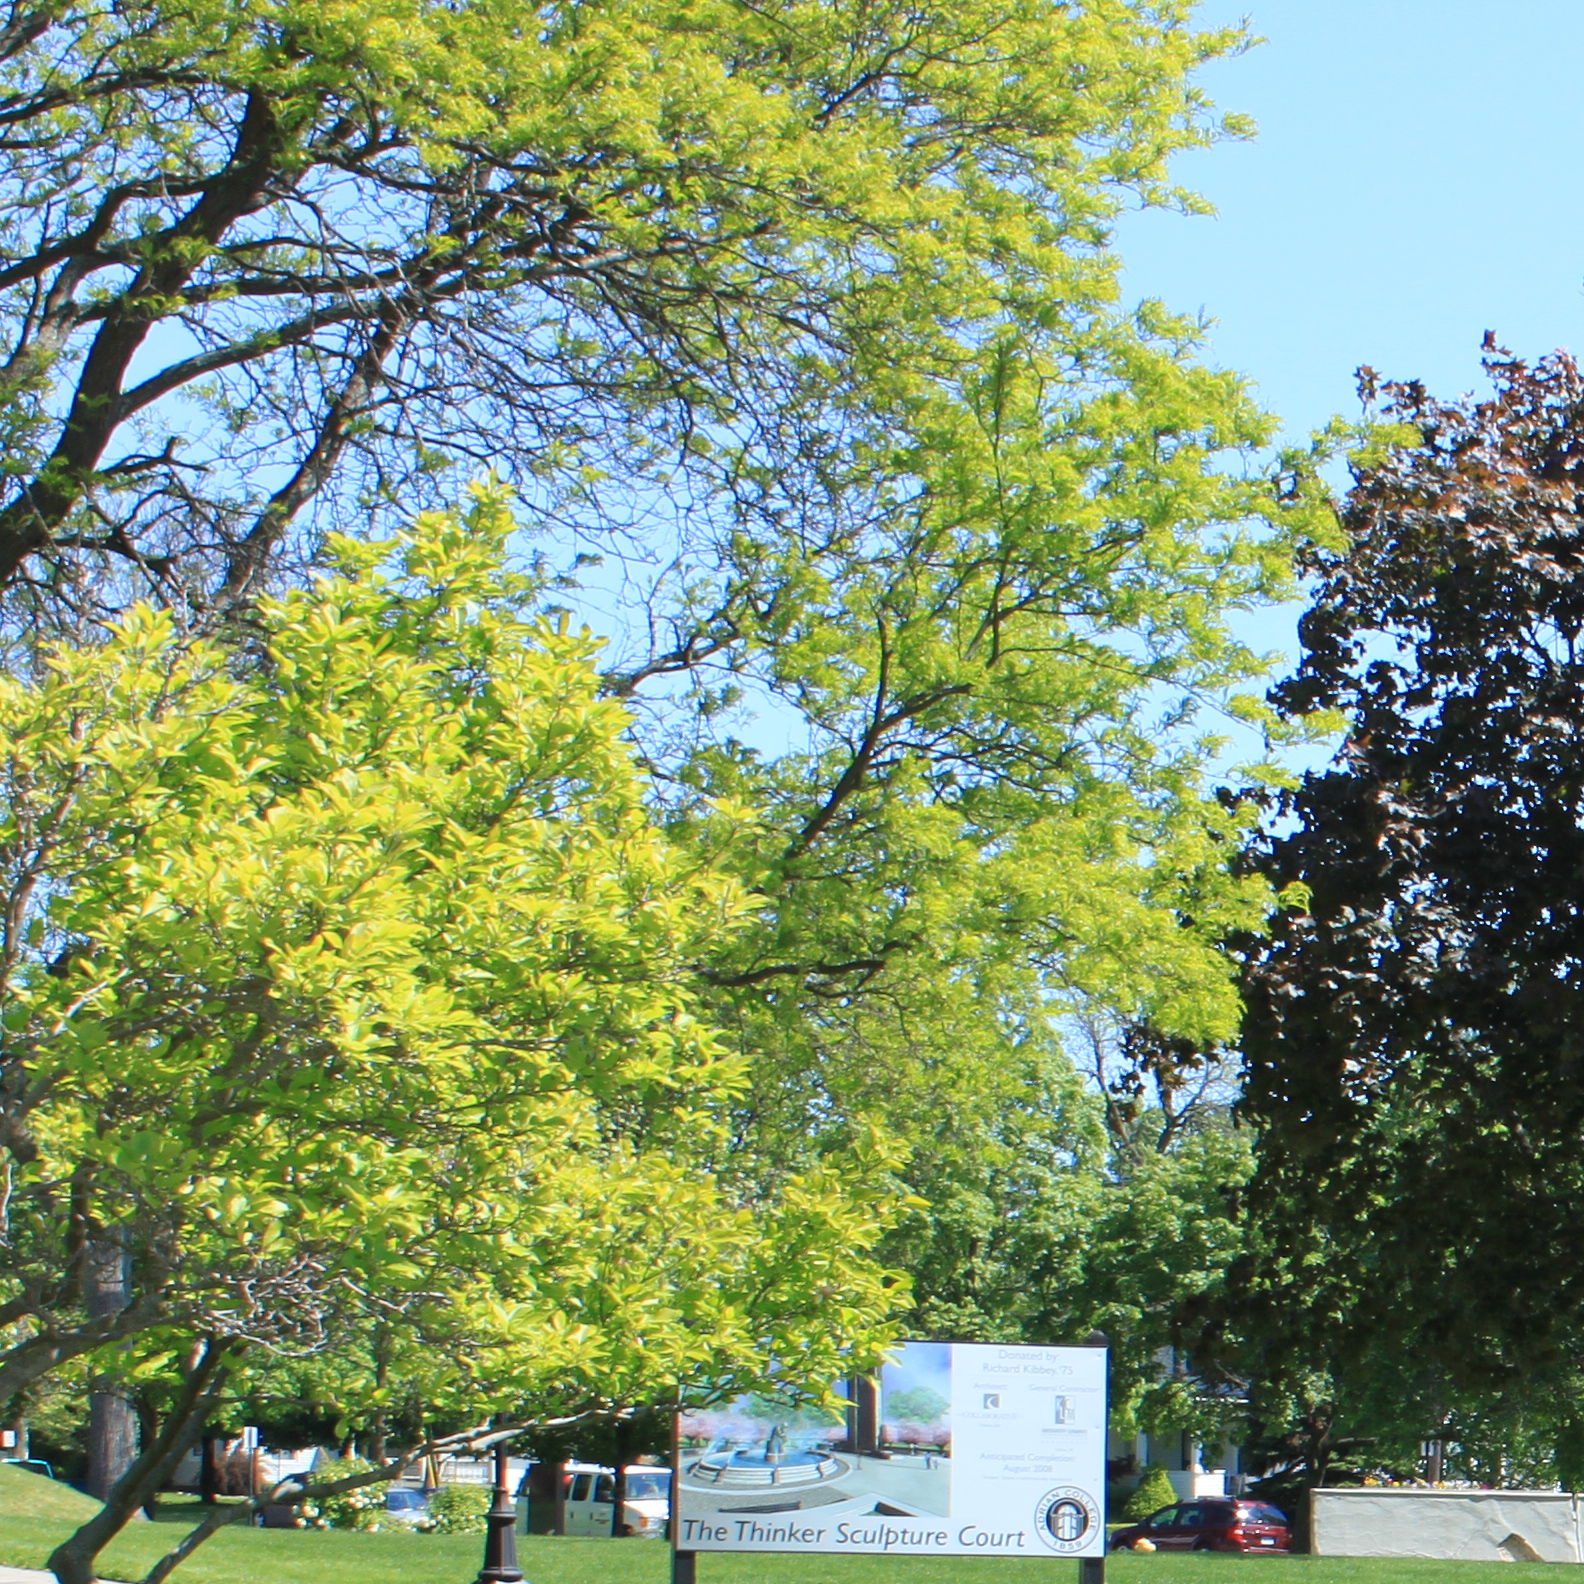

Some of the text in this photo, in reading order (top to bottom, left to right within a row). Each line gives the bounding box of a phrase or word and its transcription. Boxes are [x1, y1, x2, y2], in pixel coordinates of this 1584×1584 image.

[998, 1350, 1043, 1360] Donated
[982, 1363, 1020, 1373] Richard
[1038, 1489, 1098, 1531] ADRIAN COLLEGE
[683, 1519, 1027, 1551] The Thinker Sculpture Court
[1052, 1540, 1082, 1550] 1859
